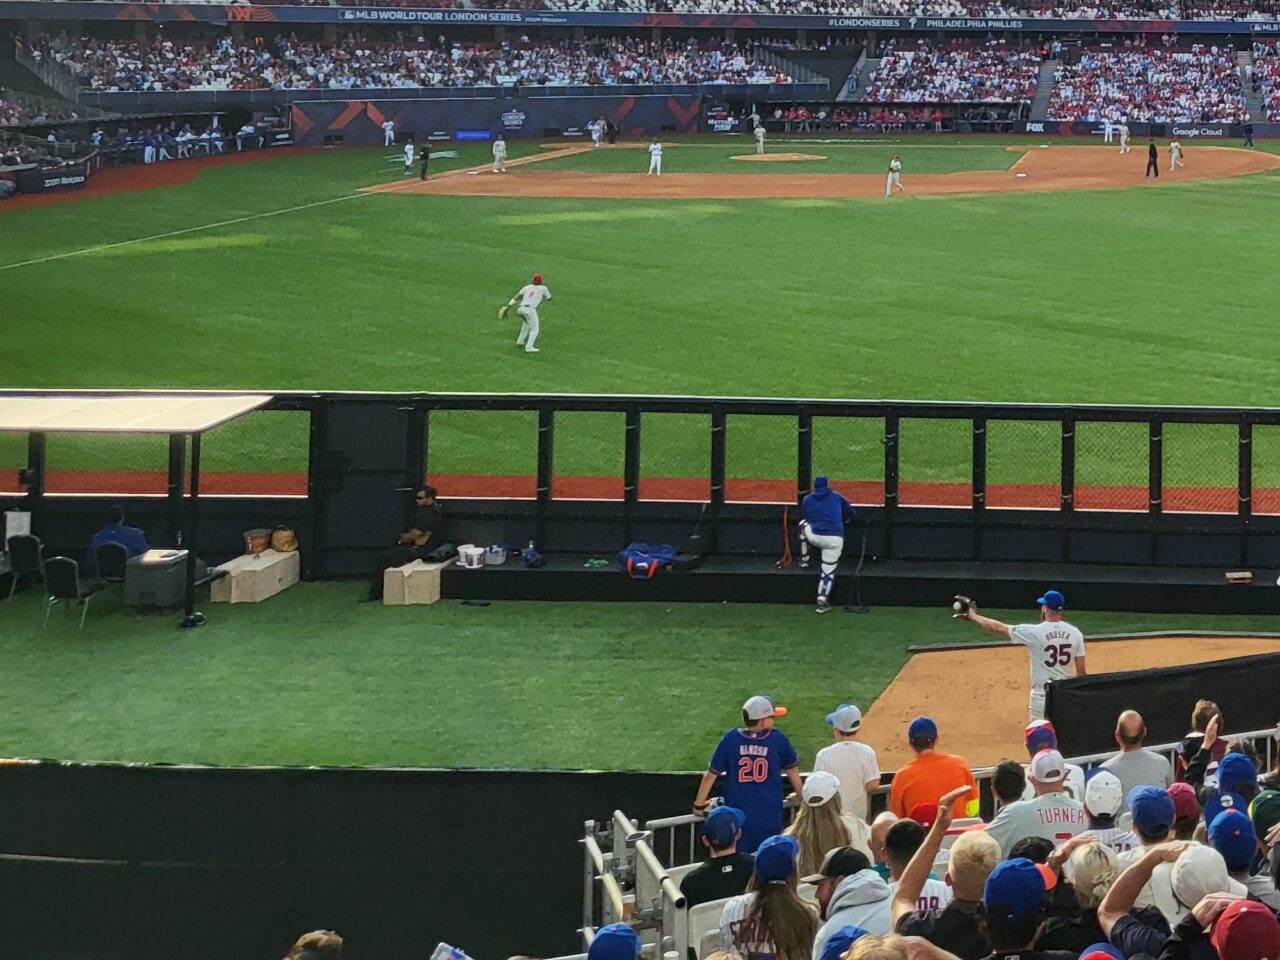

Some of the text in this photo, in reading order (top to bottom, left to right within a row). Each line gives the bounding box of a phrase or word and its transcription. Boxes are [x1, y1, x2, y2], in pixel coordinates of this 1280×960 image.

[356, 10, 522, 22] MLB WORLD TOUR LONDON SERIES
[828, 18, 900, 28] #LONDONSERIES
[926, 20, 987, 28] PHILADELPHIA
[1026, 122, 1044, 132] FOX
[1172, 127, 1222, 138] Google Cloud
[1044, 644, 1072, 668] 35
[738, 756, 768, 782] 20
[1036, 808, 1084, 824] TURNER
